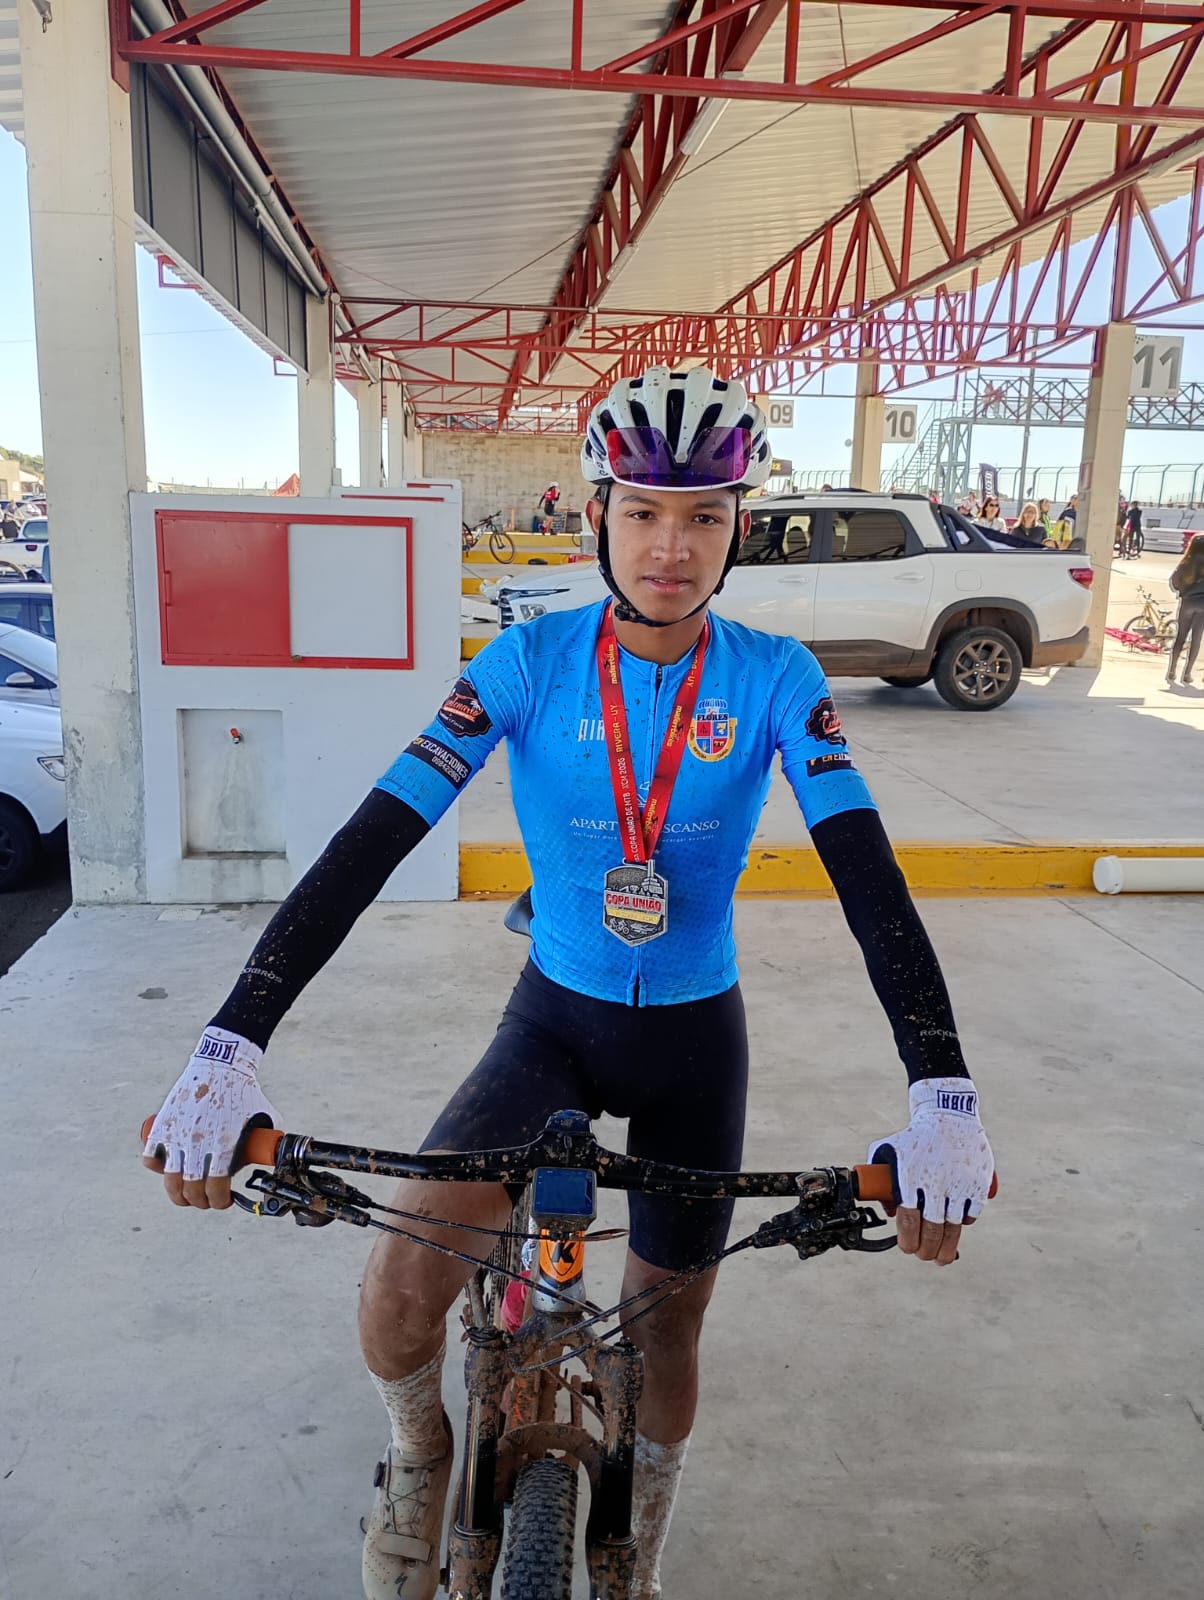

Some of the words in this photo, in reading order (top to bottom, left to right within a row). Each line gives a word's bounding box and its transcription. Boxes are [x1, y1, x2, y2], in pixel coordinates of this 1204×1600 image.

[1133, 345, 1180, 389] 11
[770, 404, 793, 424] 09
[886, 410, 915, 437] 10
[609, 704, 618, 716] UY
[612, 722, 625, 753] RIVERA
[420, 739, 469, 778] EXCAVACIONES
[625, 805, 633, 816] DE
[569, 817, 618, 831] APART
[662, 819, 720, 834] SCANSO
[629, 836, 638, 854] COPA
[606, 894, 630, 906] COPA
